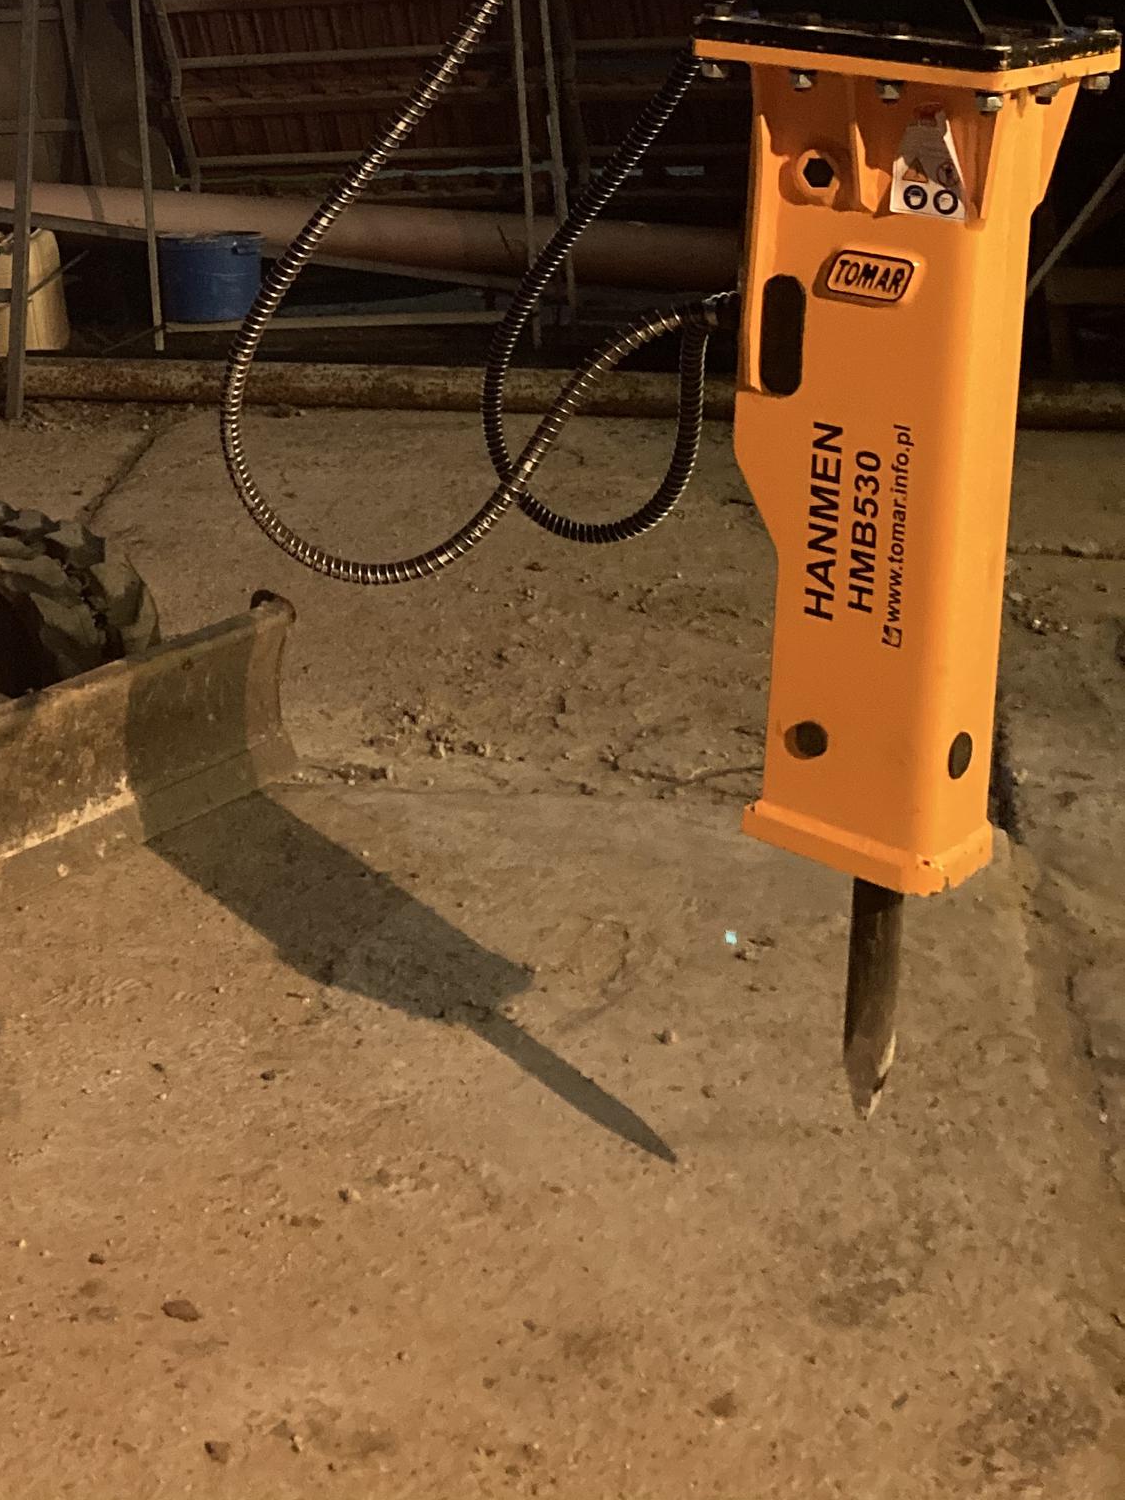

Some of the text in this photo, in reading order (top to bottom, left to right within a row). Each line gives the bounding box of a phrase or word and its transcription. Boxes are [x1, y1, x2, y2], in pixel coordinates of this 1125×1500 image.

[834, 260, 906, 294] TOMAR
[803, 420, 844, 622] HANMEN
[847, 450, 882, 614] HMB530
[886, 423, 915, 623] www.tomar.info.pl
